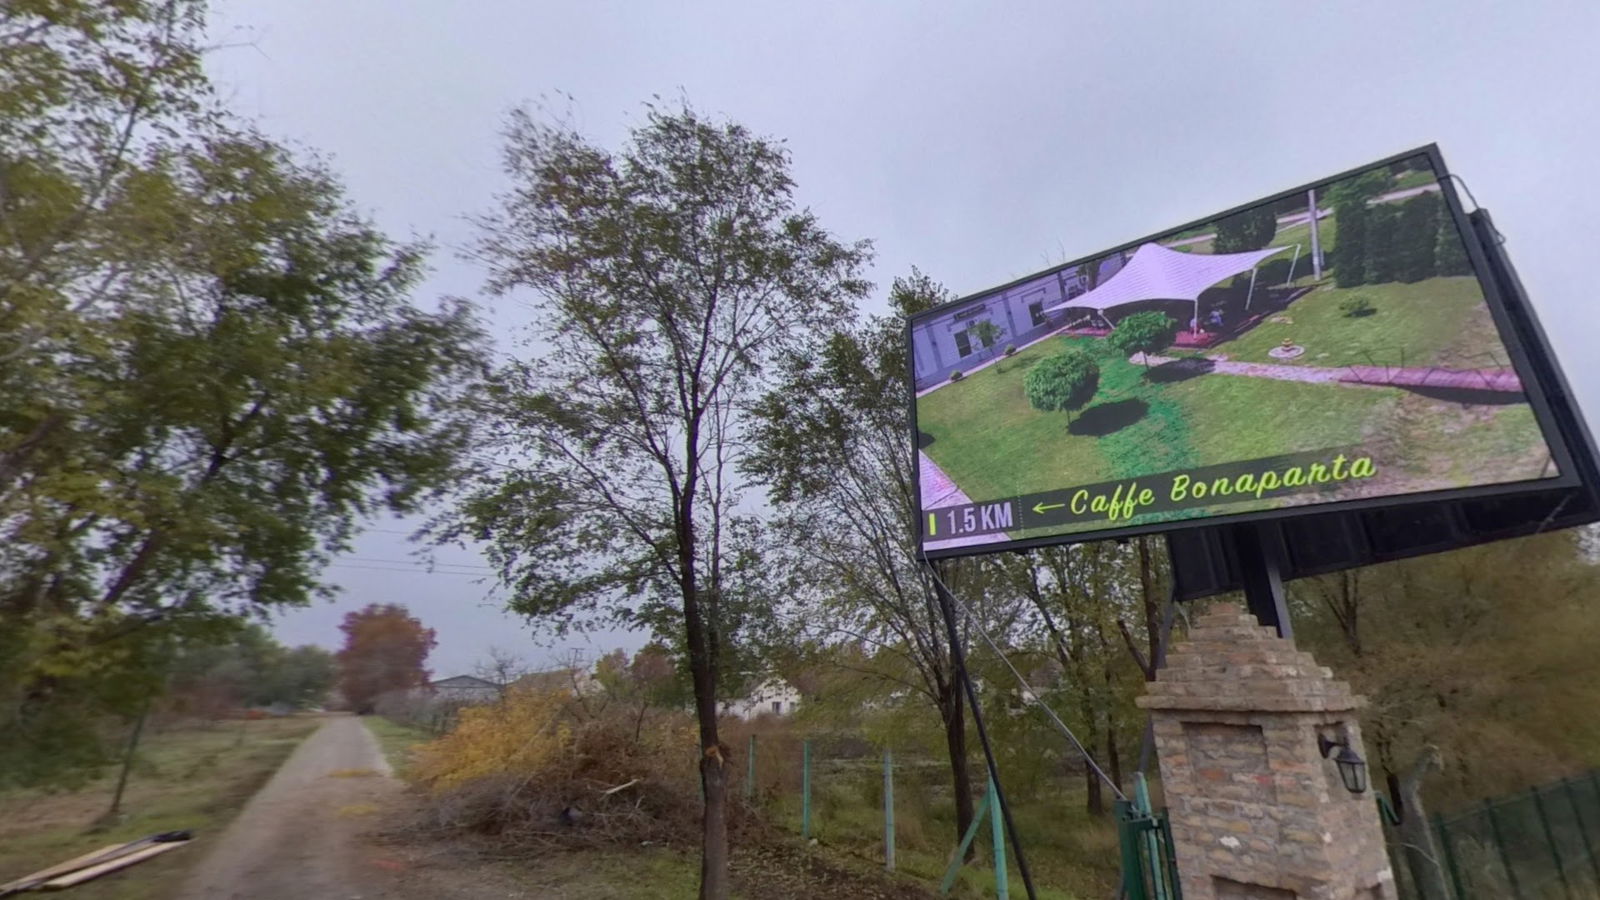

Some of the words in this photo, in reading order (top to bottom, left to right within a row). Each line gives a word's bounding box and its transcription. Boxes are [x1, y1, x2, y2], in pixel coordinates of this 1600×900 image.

[1071, 483, 1154, 521] Caffe
[1170, 454, 1377, 501] Bonaparta
[947, 507, 975, 534] 1.5
[981, 502, 1013, 530] KM
